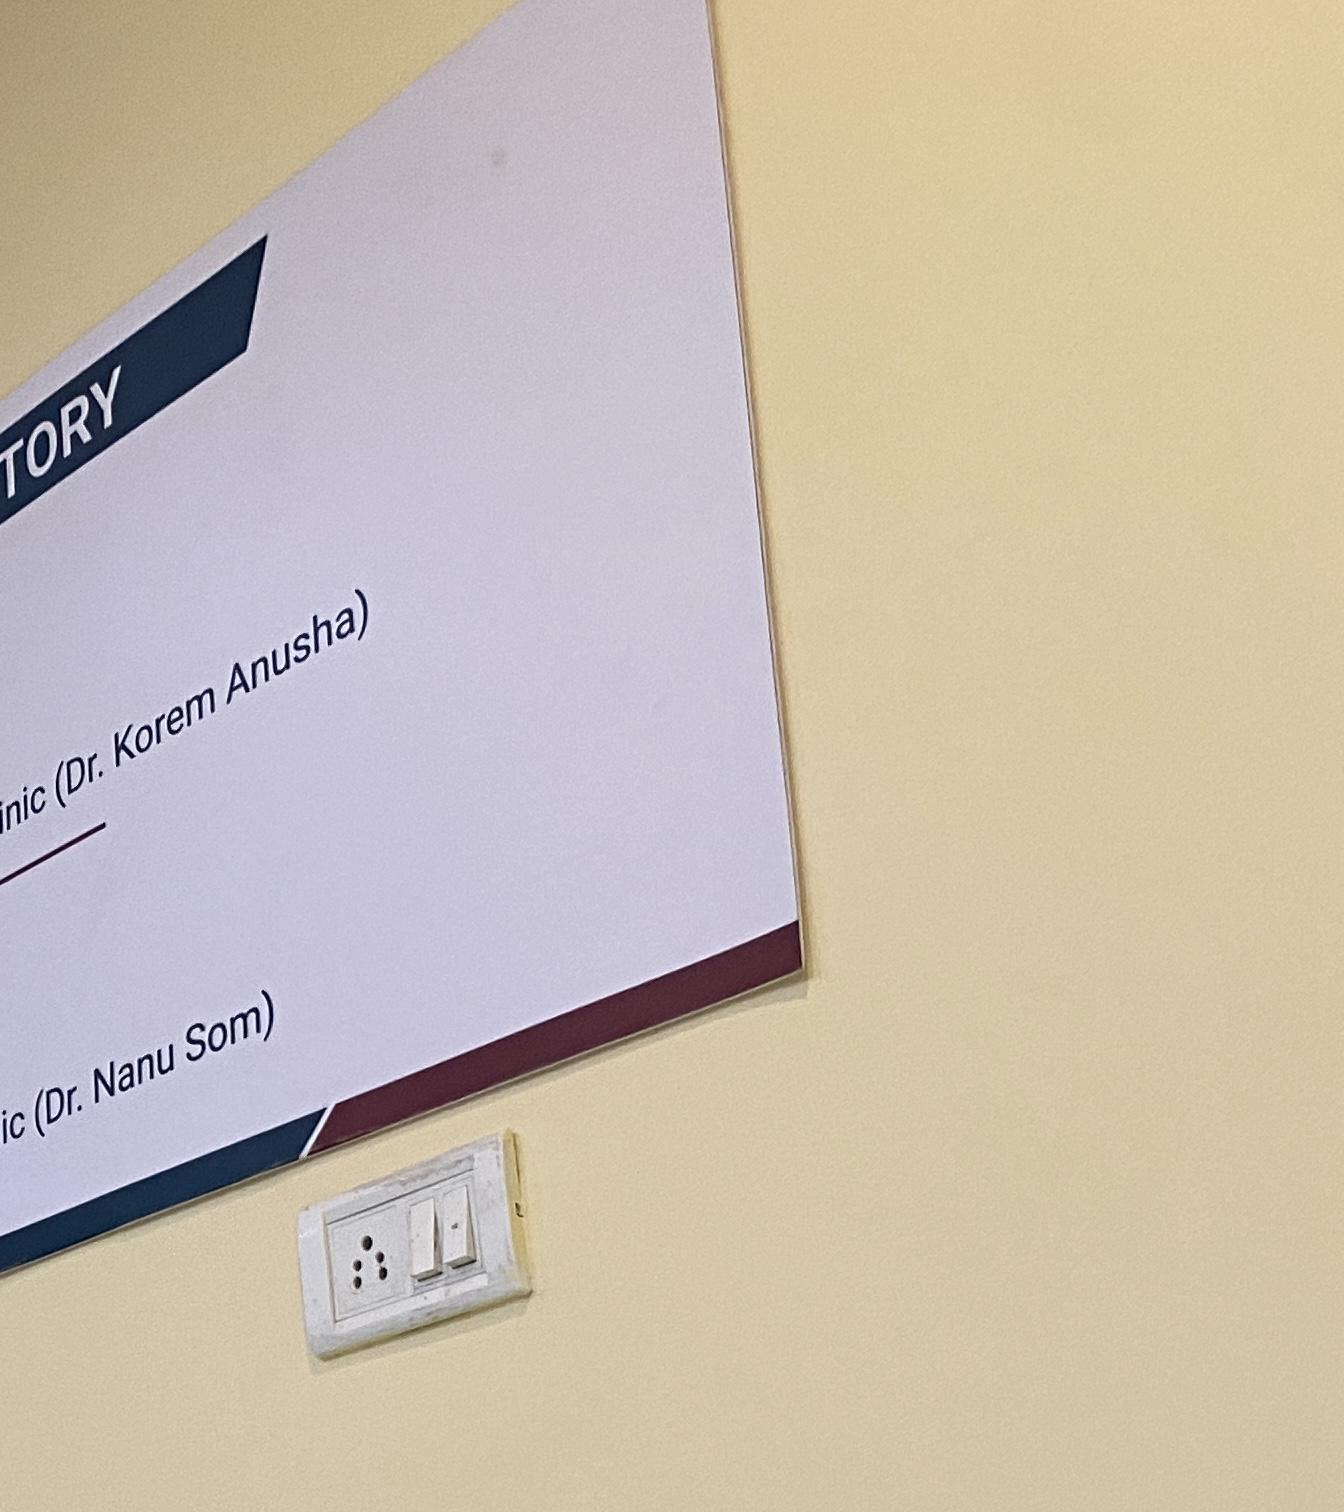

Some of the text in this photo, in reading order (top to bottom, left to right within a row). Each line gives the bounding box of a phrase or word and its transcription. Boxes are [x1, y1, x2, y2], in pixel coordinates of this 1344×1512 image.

[55, 752, 104, 807] (Dr.
[113, 687, 216, 768] Korem
[226, 589, 369, 705] Anusha)
[34, 1085, 83, 1138] (Dr.
[93, 1043, 175, 1104] Nanu
[185, 990, 274, 1062] Som)
